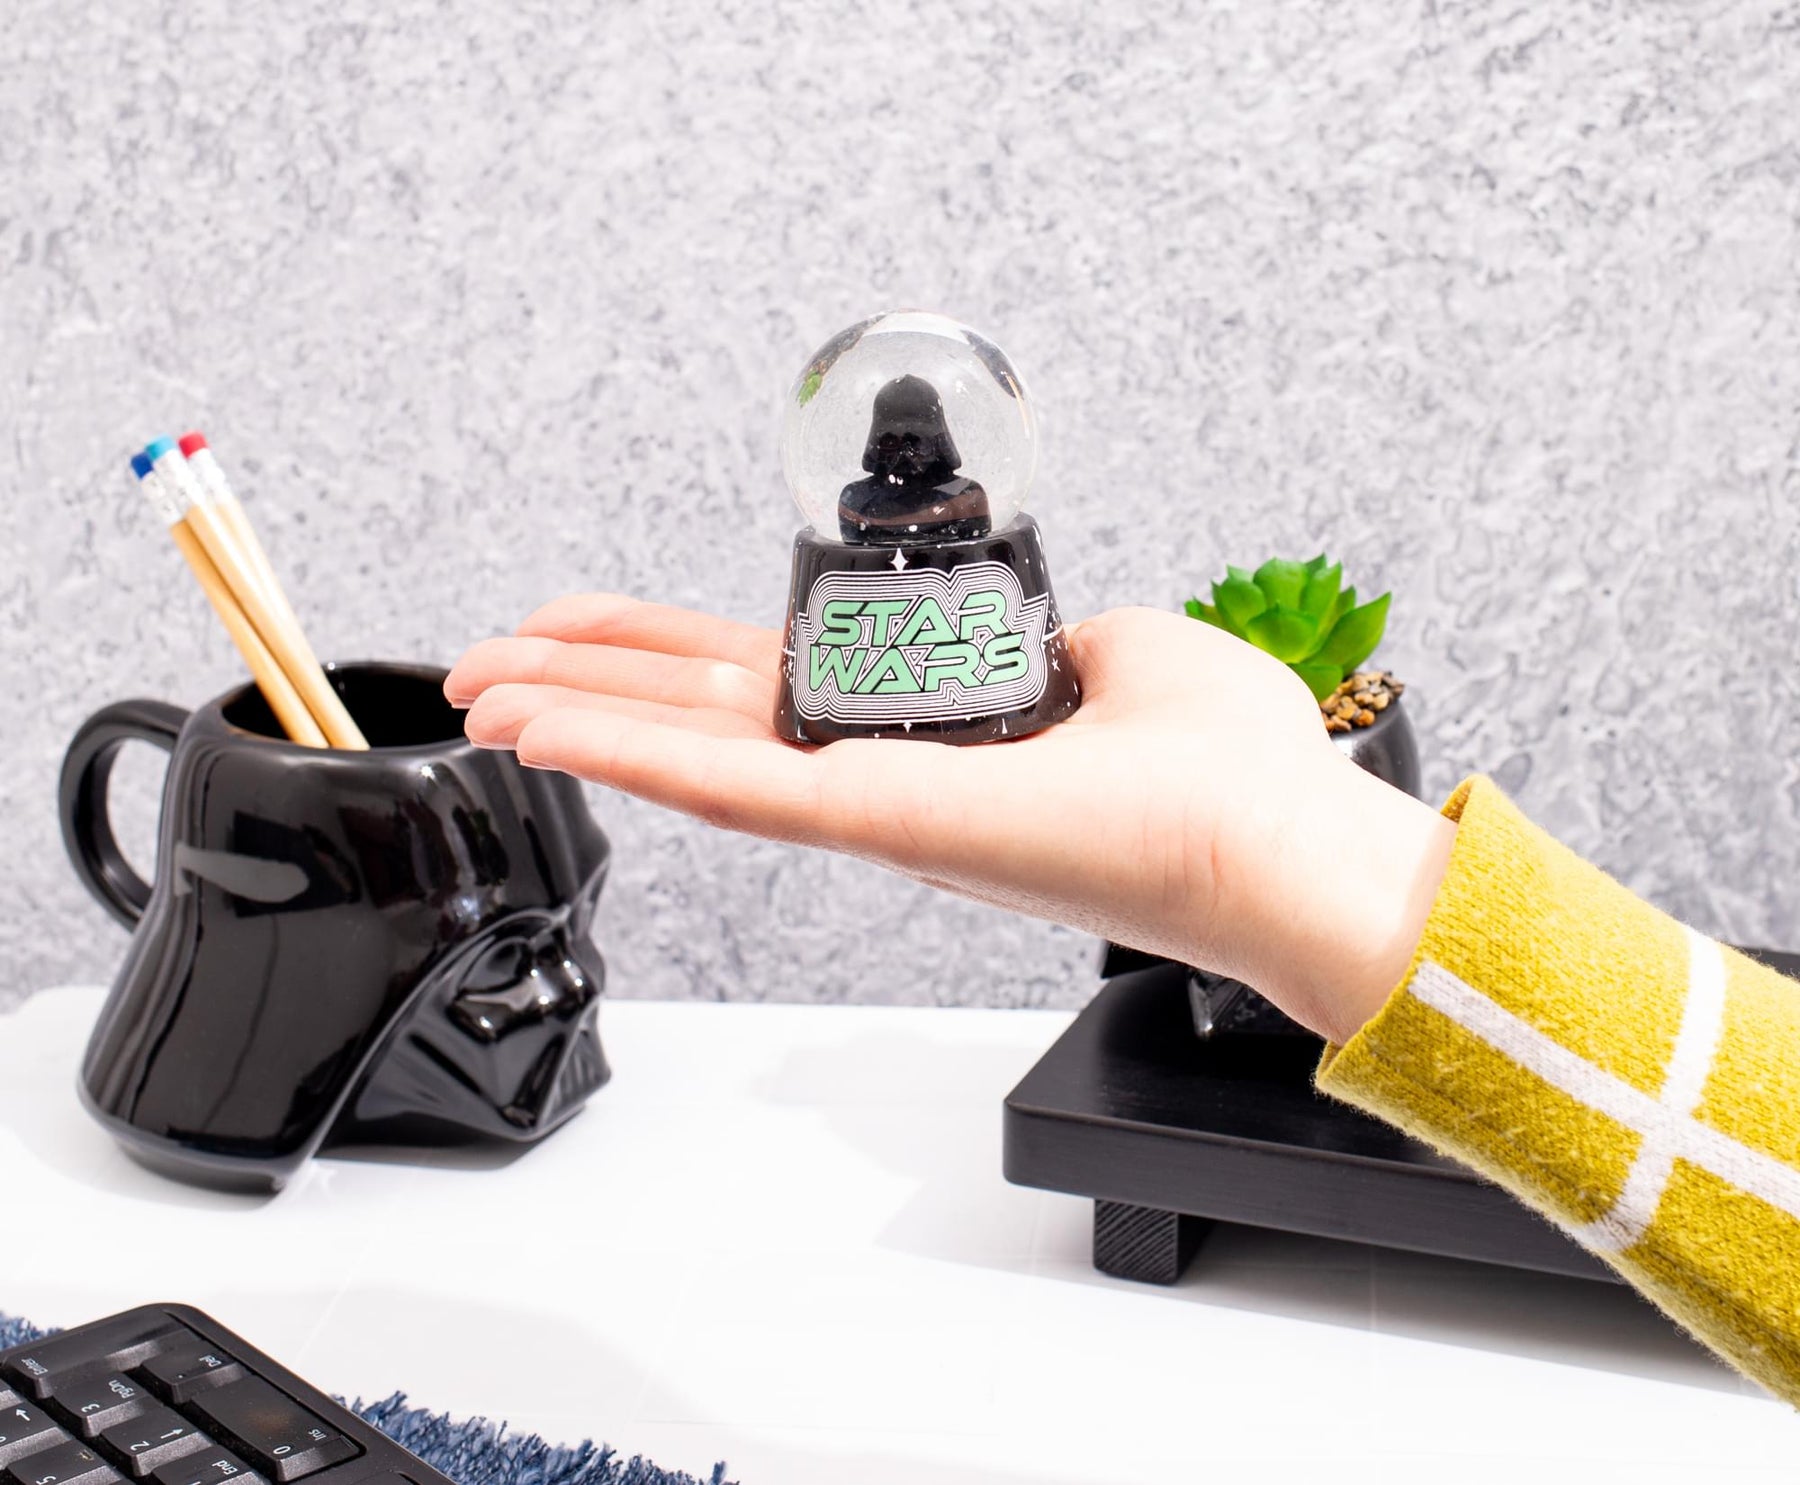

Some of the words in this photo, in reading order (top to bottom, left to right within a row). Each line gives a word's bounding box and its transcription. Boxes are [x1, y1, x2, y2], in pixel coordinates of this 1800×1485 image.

[817, 590, 1008, 647] STAR
[808, 632, 1030, 695] WARS
[21, 1357, 48, 1375] Enter
[199, 1355, 222, 1368] Del
[108, 1379, 135, 1399] PgDn
[81, 1403, 100, 1413] 3
[308, 1428, 327, 1441] Ins
[130, 1441, 151, 1451] 2
[212, 1460, 238, 1475] End
[36, 1475, 56, 1485] 5
